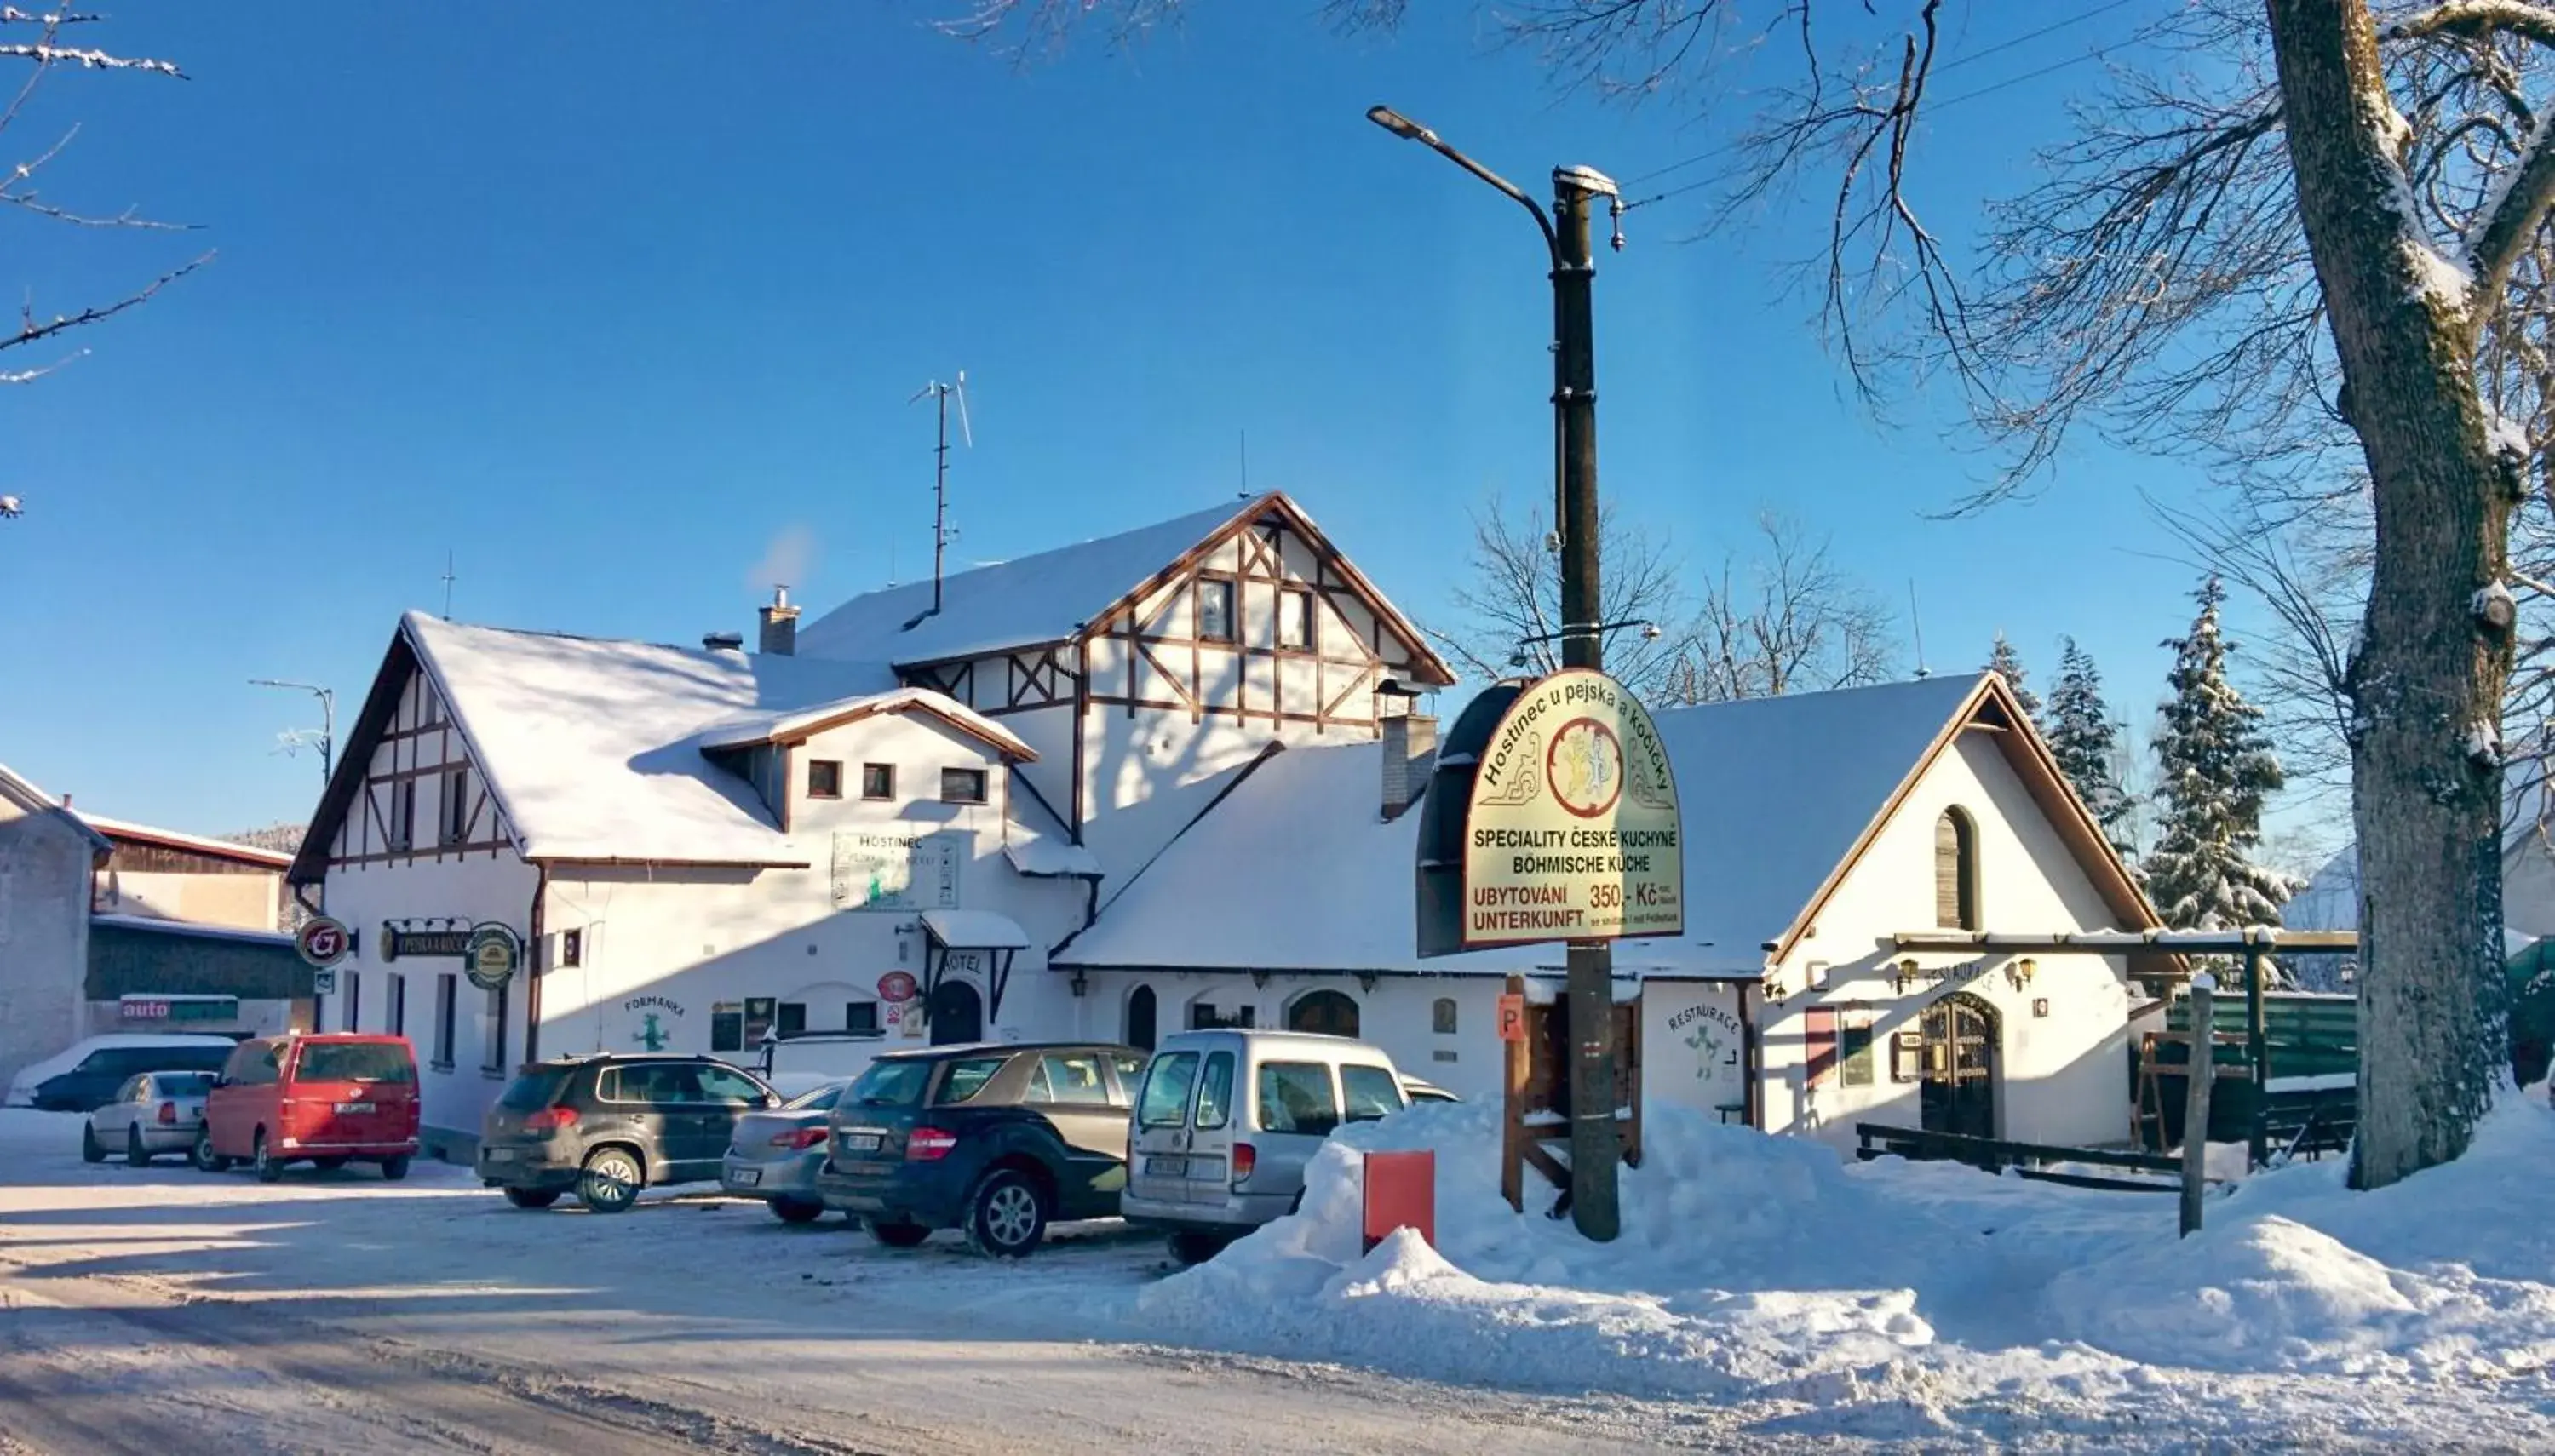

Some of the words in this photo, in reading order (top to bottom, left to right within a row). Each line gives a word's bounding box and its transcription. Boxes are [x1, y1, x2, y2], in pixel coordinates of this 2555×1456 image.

[1484, 696, 1547, 786] Hostinec
[1550, 688, 1560, 705] u
[1565, 679, 1616, 708] pejska
[1619, 700, 1628, 716] a
[859, 835, 922, 849] HOSTINEC
[1474, 829, 1566, 847] SPECIALITY
[1474, 883, 1568, 906] UBYTOVÁNÍ
[1636, 882, 1656, 907] Kč
[1473, 909, 1584, 930] UNTERKUNFT
[123, 1001, 168, 1017] auto
[624, 995, 685, 1017] FORMANKA
[1504, 1010, 1518, 1032] P
[1668, 1004, 1739, 1035] RESTAURACE
